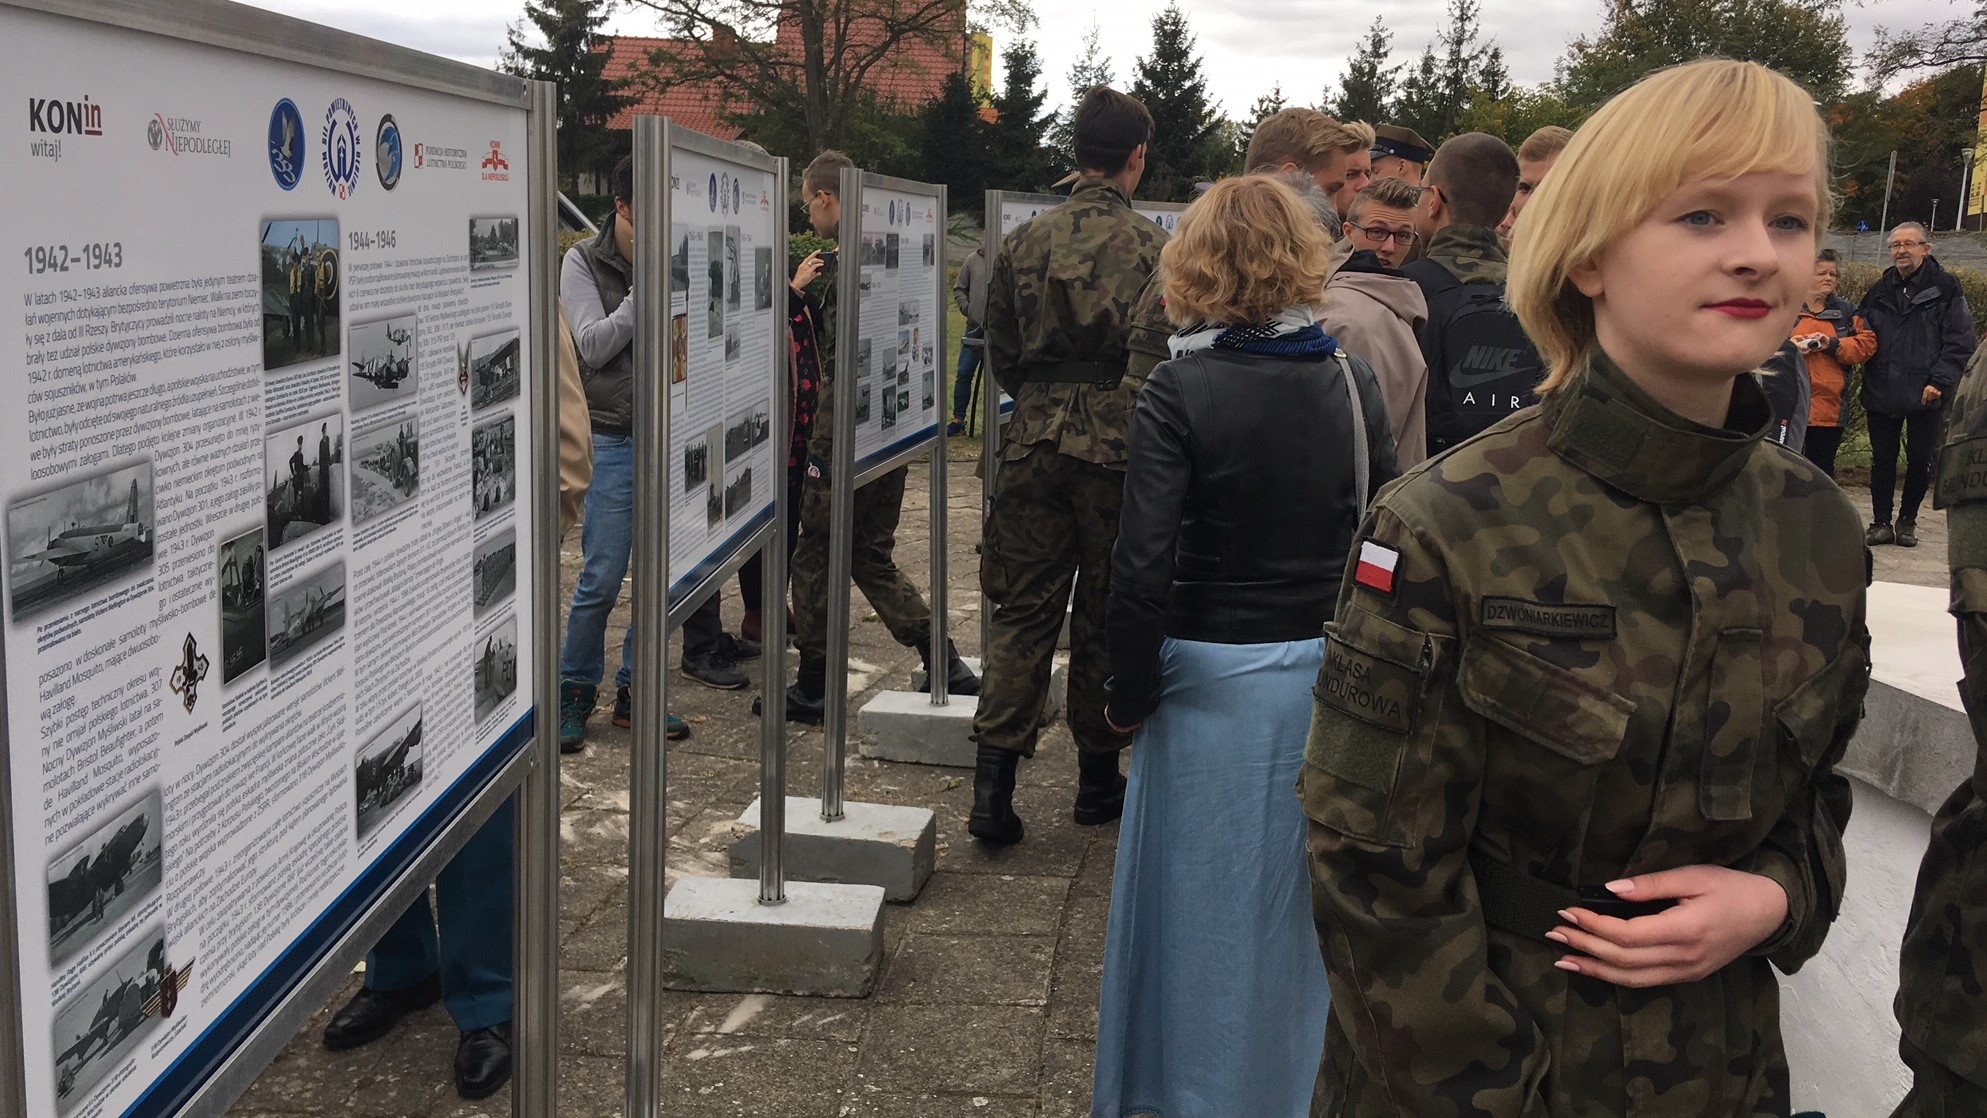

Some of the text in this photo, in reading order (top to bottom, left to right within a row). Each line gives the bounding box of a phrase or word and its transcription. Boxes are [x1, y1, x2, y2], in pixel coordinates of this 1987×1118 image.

[168, 116, 202, 133] SŁUŻYMY
[31, 137, 62, 162] witaj!
[165, 131, 231, 158] NIEPODLEGŁEJ
[24, 281, 190, 306] W latach aliancka ofensywa powietrzna
[26, 299, 156, 326] łań wojennych dotykającym bezpośrednio
[26, 309, 209, 348] ły się z dala od prowadzili nocne naloty
[26, 326, 217, 366] brały udział polskie dywizjony Dzienna ofensywa
[28, 342, 205, 384] 1942 domeną lotnictwa które korzystało
[1461, 345, 1521, 371] NIKE
[28, 379, 109, 404] ców sojuszników, w tym
[29, 378, 190, 424] Było jasne, wojna potrwa jeszcze polskie
[1463, 391, 1520, 409] AIR
[29, 400, 171, 442] lotnictwo, były odcięte od swojego naturalnego
[30, 418, 162, 461] we były straty ponoszone przez dywizjony
[31, 425, 200, 480] loosobowymi Dlatego podjęto kolejne zmiany
[155, 429, 233, 462] Dywizjon 304 do
[182, 458, 190, 469] ale
[186, 482, 218, 499] Na początku
[173, 505, 197, 521] Dywizjon
[158, 530, 214, 559] we 1943 Dywizjon
[158, 544, 215, 576] 305 przeniesiono do
[159, 575, 183, 592] lotnictwa
[1486, 604, 1610, 629] DZWONIARKIEWICZ
[39, 625, 146, 687] posażono w doskonałe samoloty
[40, 650, 127, 702] Havilland mające
[1317, 668, 1401, 719] UNDUROWA
[41, 674, 146, 739] Szybki postęp techniczny okresu
[42, 679, 162, 757] ny nie omijał polskiego 307
[42, 703, 151, 773] Nocny Dywizjon Myśliwski latał na
[43, 713, 163, 792] molotach Bristol potem
[196, 754, 219, 774] Dywizjon
[220, 745, 230, 758] 304
[44, 773, 88, 810] de Havilland
[44, 770, 123, 828] nych w pokładowe stacje
[45, 783, 127, 845] ne pozwalające wykrywać
